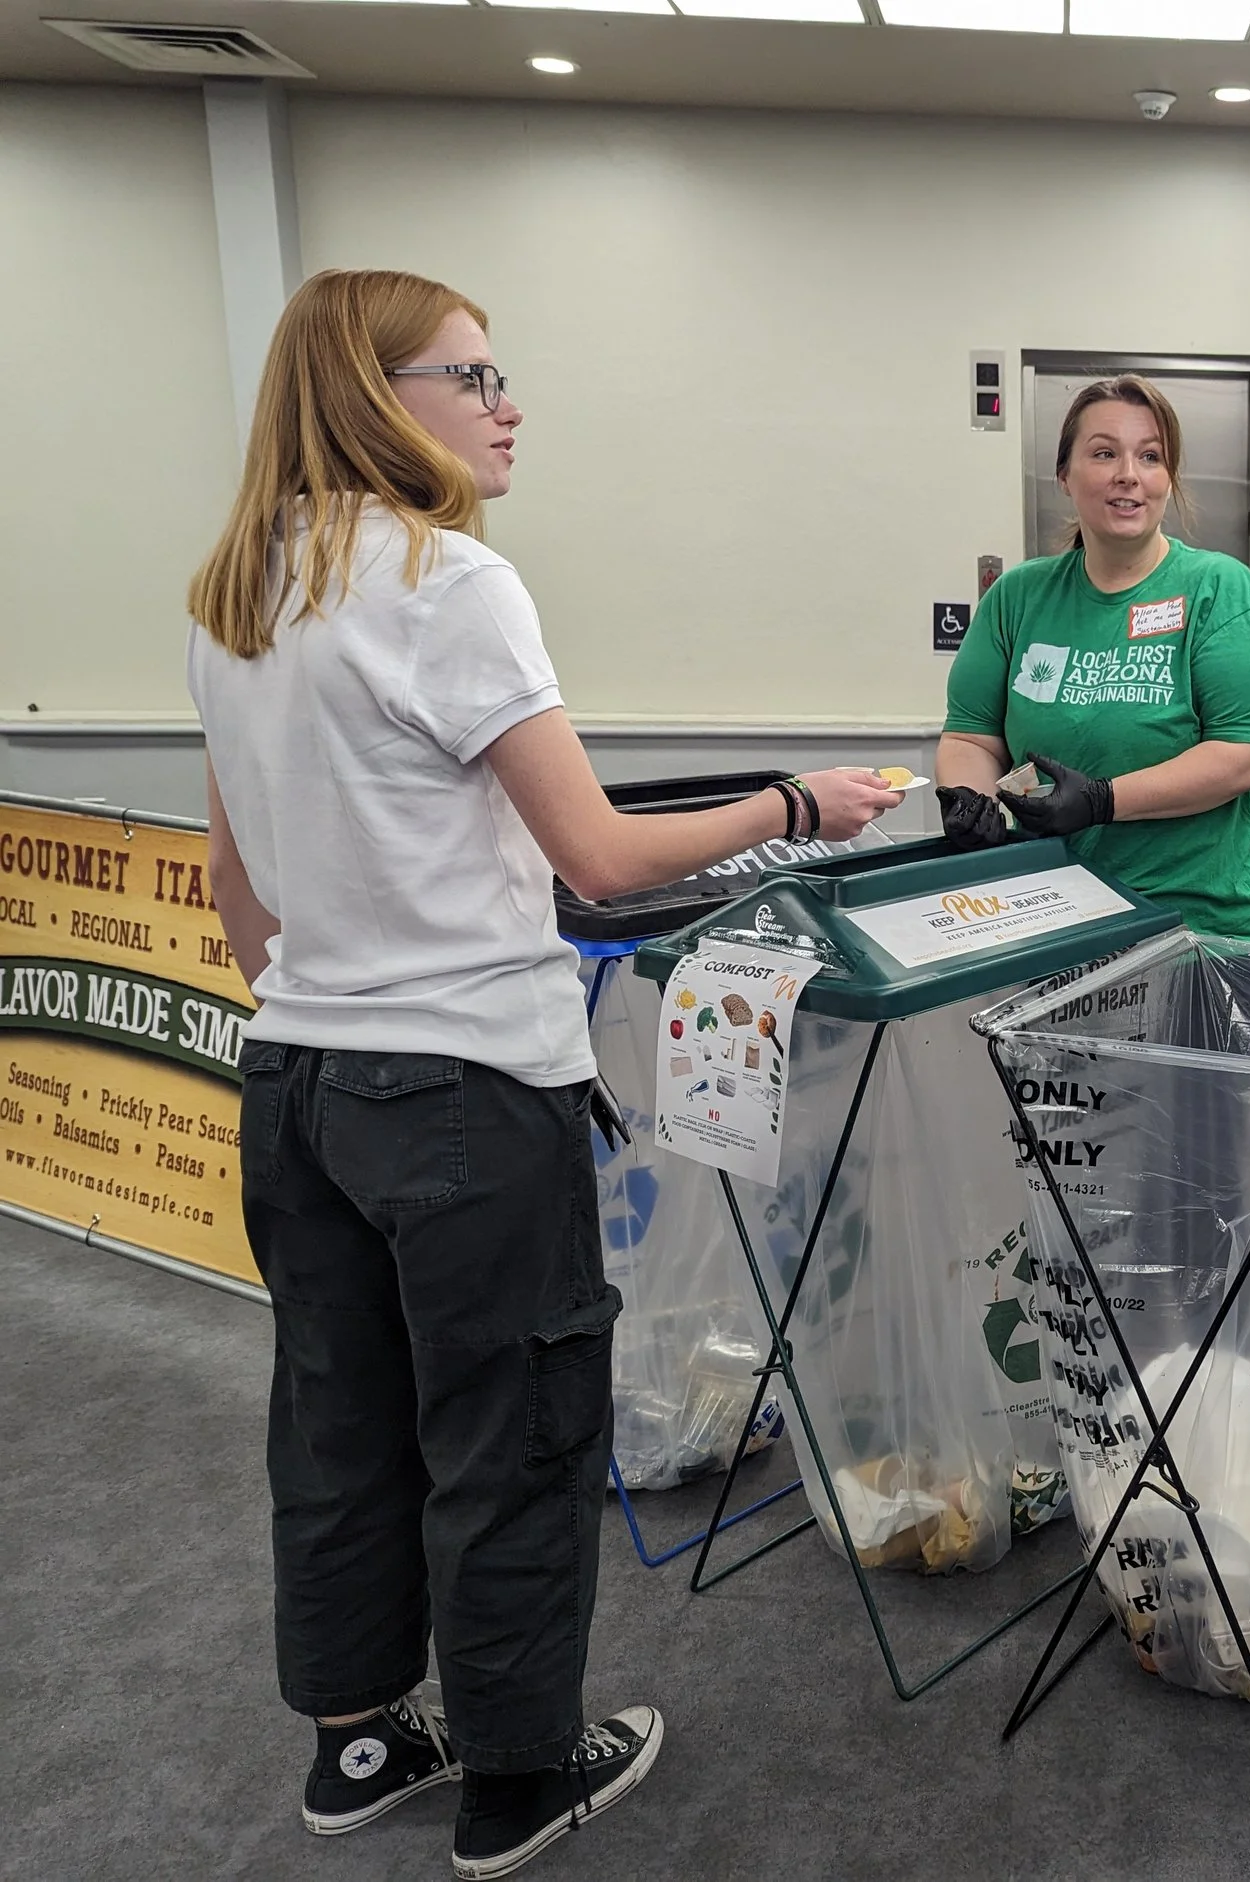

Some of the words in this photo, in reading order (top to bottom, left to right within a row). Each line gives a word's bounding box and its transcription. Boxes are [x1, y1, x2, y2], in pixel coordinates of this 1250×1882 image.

[1065, 663, 1175, 686] ARIZONA
[1072, 647, 1121, 669] LOCAL
[1126, 644, 1176, 664] FIRST
[1060, 686, 1174, 706] SUSTAINABILITY
[0, 833, 130, 895] GOURMET
[154, 858, 217, 912] ITA
[928, 916, 955, 929] KEEP
[942, 892, 1010, 922] Phx
[1011, 891, 1064, 910] BEAUTIFUL
[945, 932, 966, 941] KEEP
[968, 924, 1003, 936] AMERICA
[1003, 914, 1043, 927] BEAUTIFUL
[1044, 904, 1078, 917] AFFILIATE
[70, 910, 153, 953] REGIONAL
[704, 960, 775, 980] COMPOST
[85, 973, 171, 1042] MADE
[8, 1061, 72, 1107] Seasoning
[100, 1088, 153, 1130] Prickly
[157, 1103, 193, 1134] Pear
[1015, 1079, 1107, 1111] ONLY
[708, 1108, 720, 1122] NO
[0, 1097, 24, 1125] Oils
[53, 1113, 120, 1155] Balsamics
[156, 1143, 205, 1179] Pastas
[5, 1149, 214, 1226] www.flavormadesimple.com
[345, 1741, 382, 1757] CONVERSE
